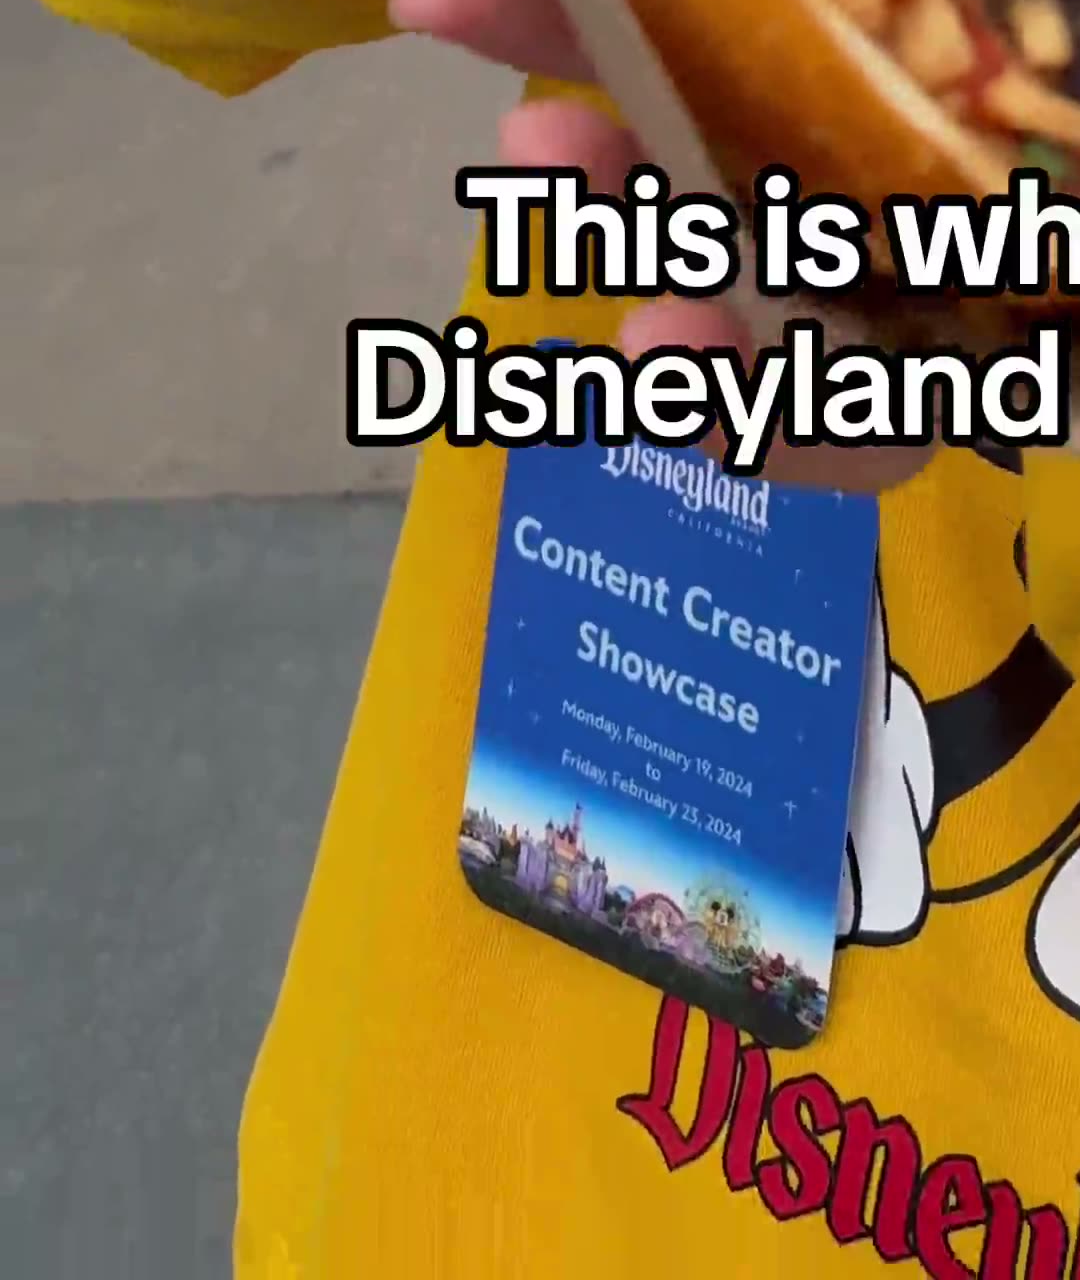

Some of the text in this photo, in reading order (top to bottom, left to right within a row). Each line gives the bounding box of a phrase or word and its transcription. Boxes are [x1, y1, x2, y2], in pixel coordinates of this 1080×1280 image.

[600, 434, 769, 529] Disneyland
[514, 515, 841, 686] Content Creator
[577, 621, 759, 733] Showcase
[561, 748, 608, 787] Friday,
[612, 770, 678, 820] February
[705, 813, 742, 846] 2024
[562, 699, 753, 798] Monday, February 19, 2024
[646, 762, 661, 781] to
